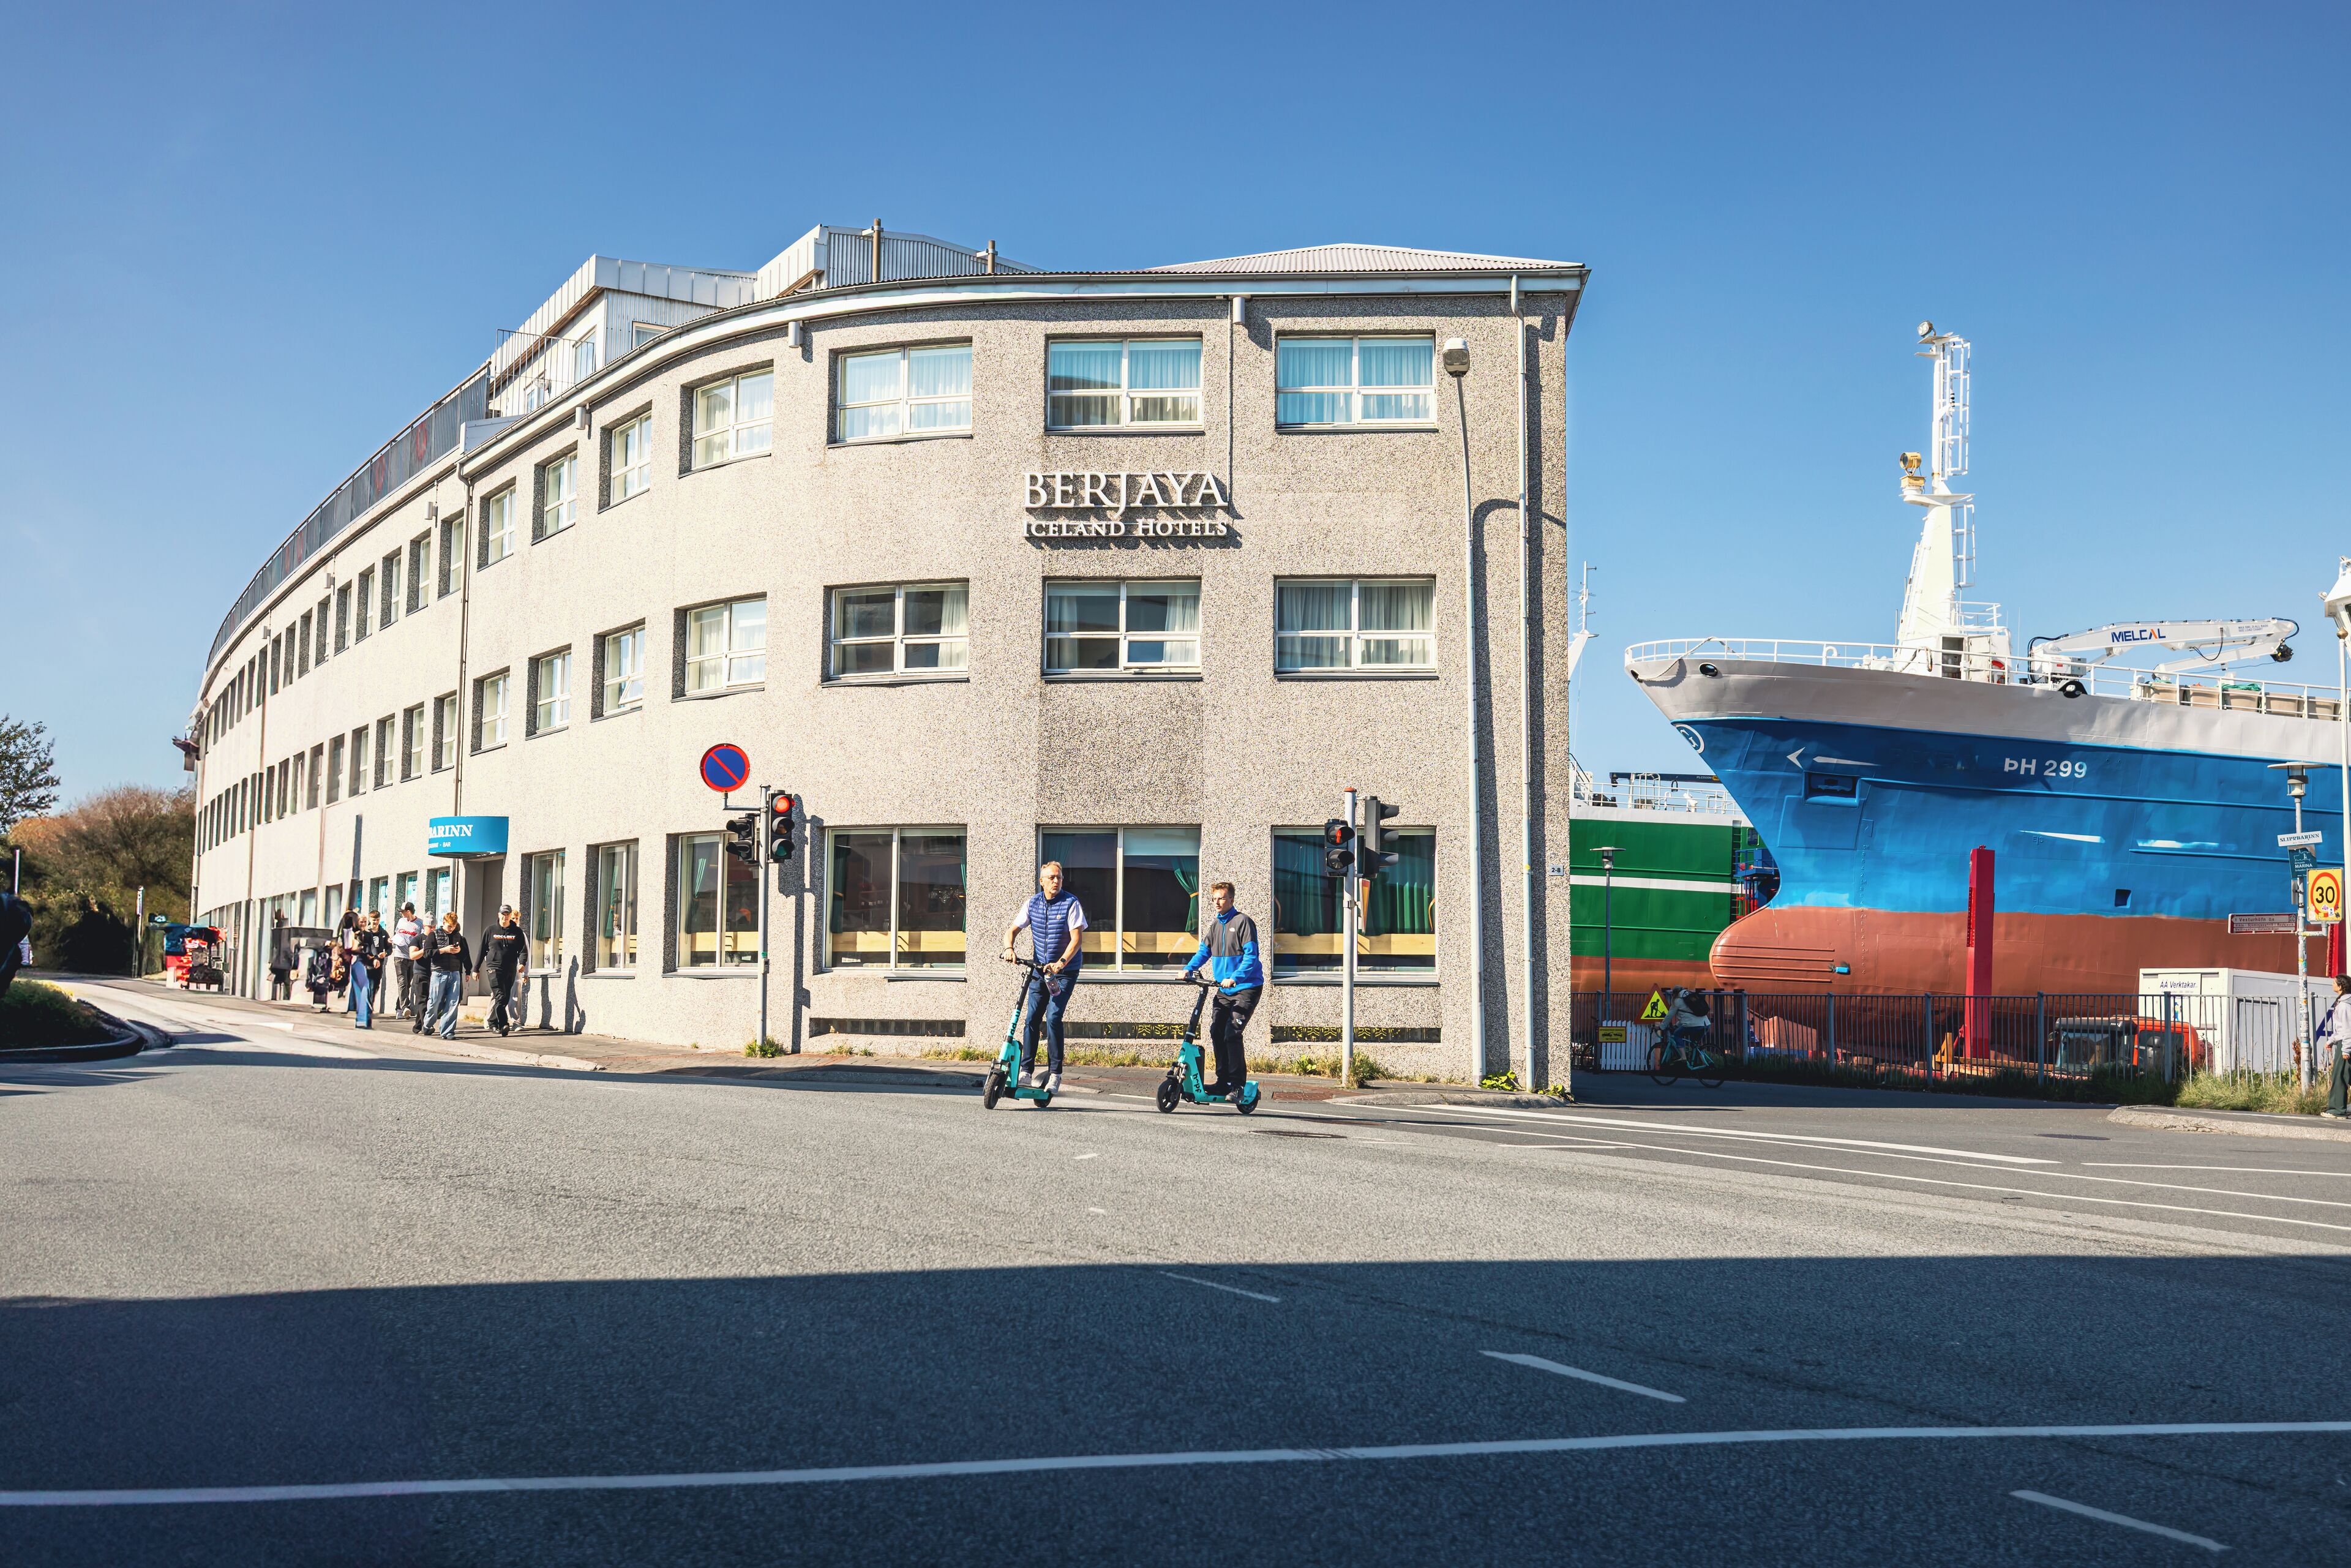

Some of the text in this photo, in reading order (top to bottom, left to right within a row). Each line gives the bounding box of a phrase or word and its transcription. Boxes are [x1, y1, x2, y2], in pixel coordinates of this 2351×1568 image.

[1023, 471, 1228, 518] BERJAYA
[1022, 519, 1228, 537] ICELAND HOTELS
[2111, 628, 2165, 642] MELCAL
[2044, 760, 2087, 778] 299
[2279, 833, 2320, 842] SLIPPBARINN
[2315, 886, 2335, 904] 30
